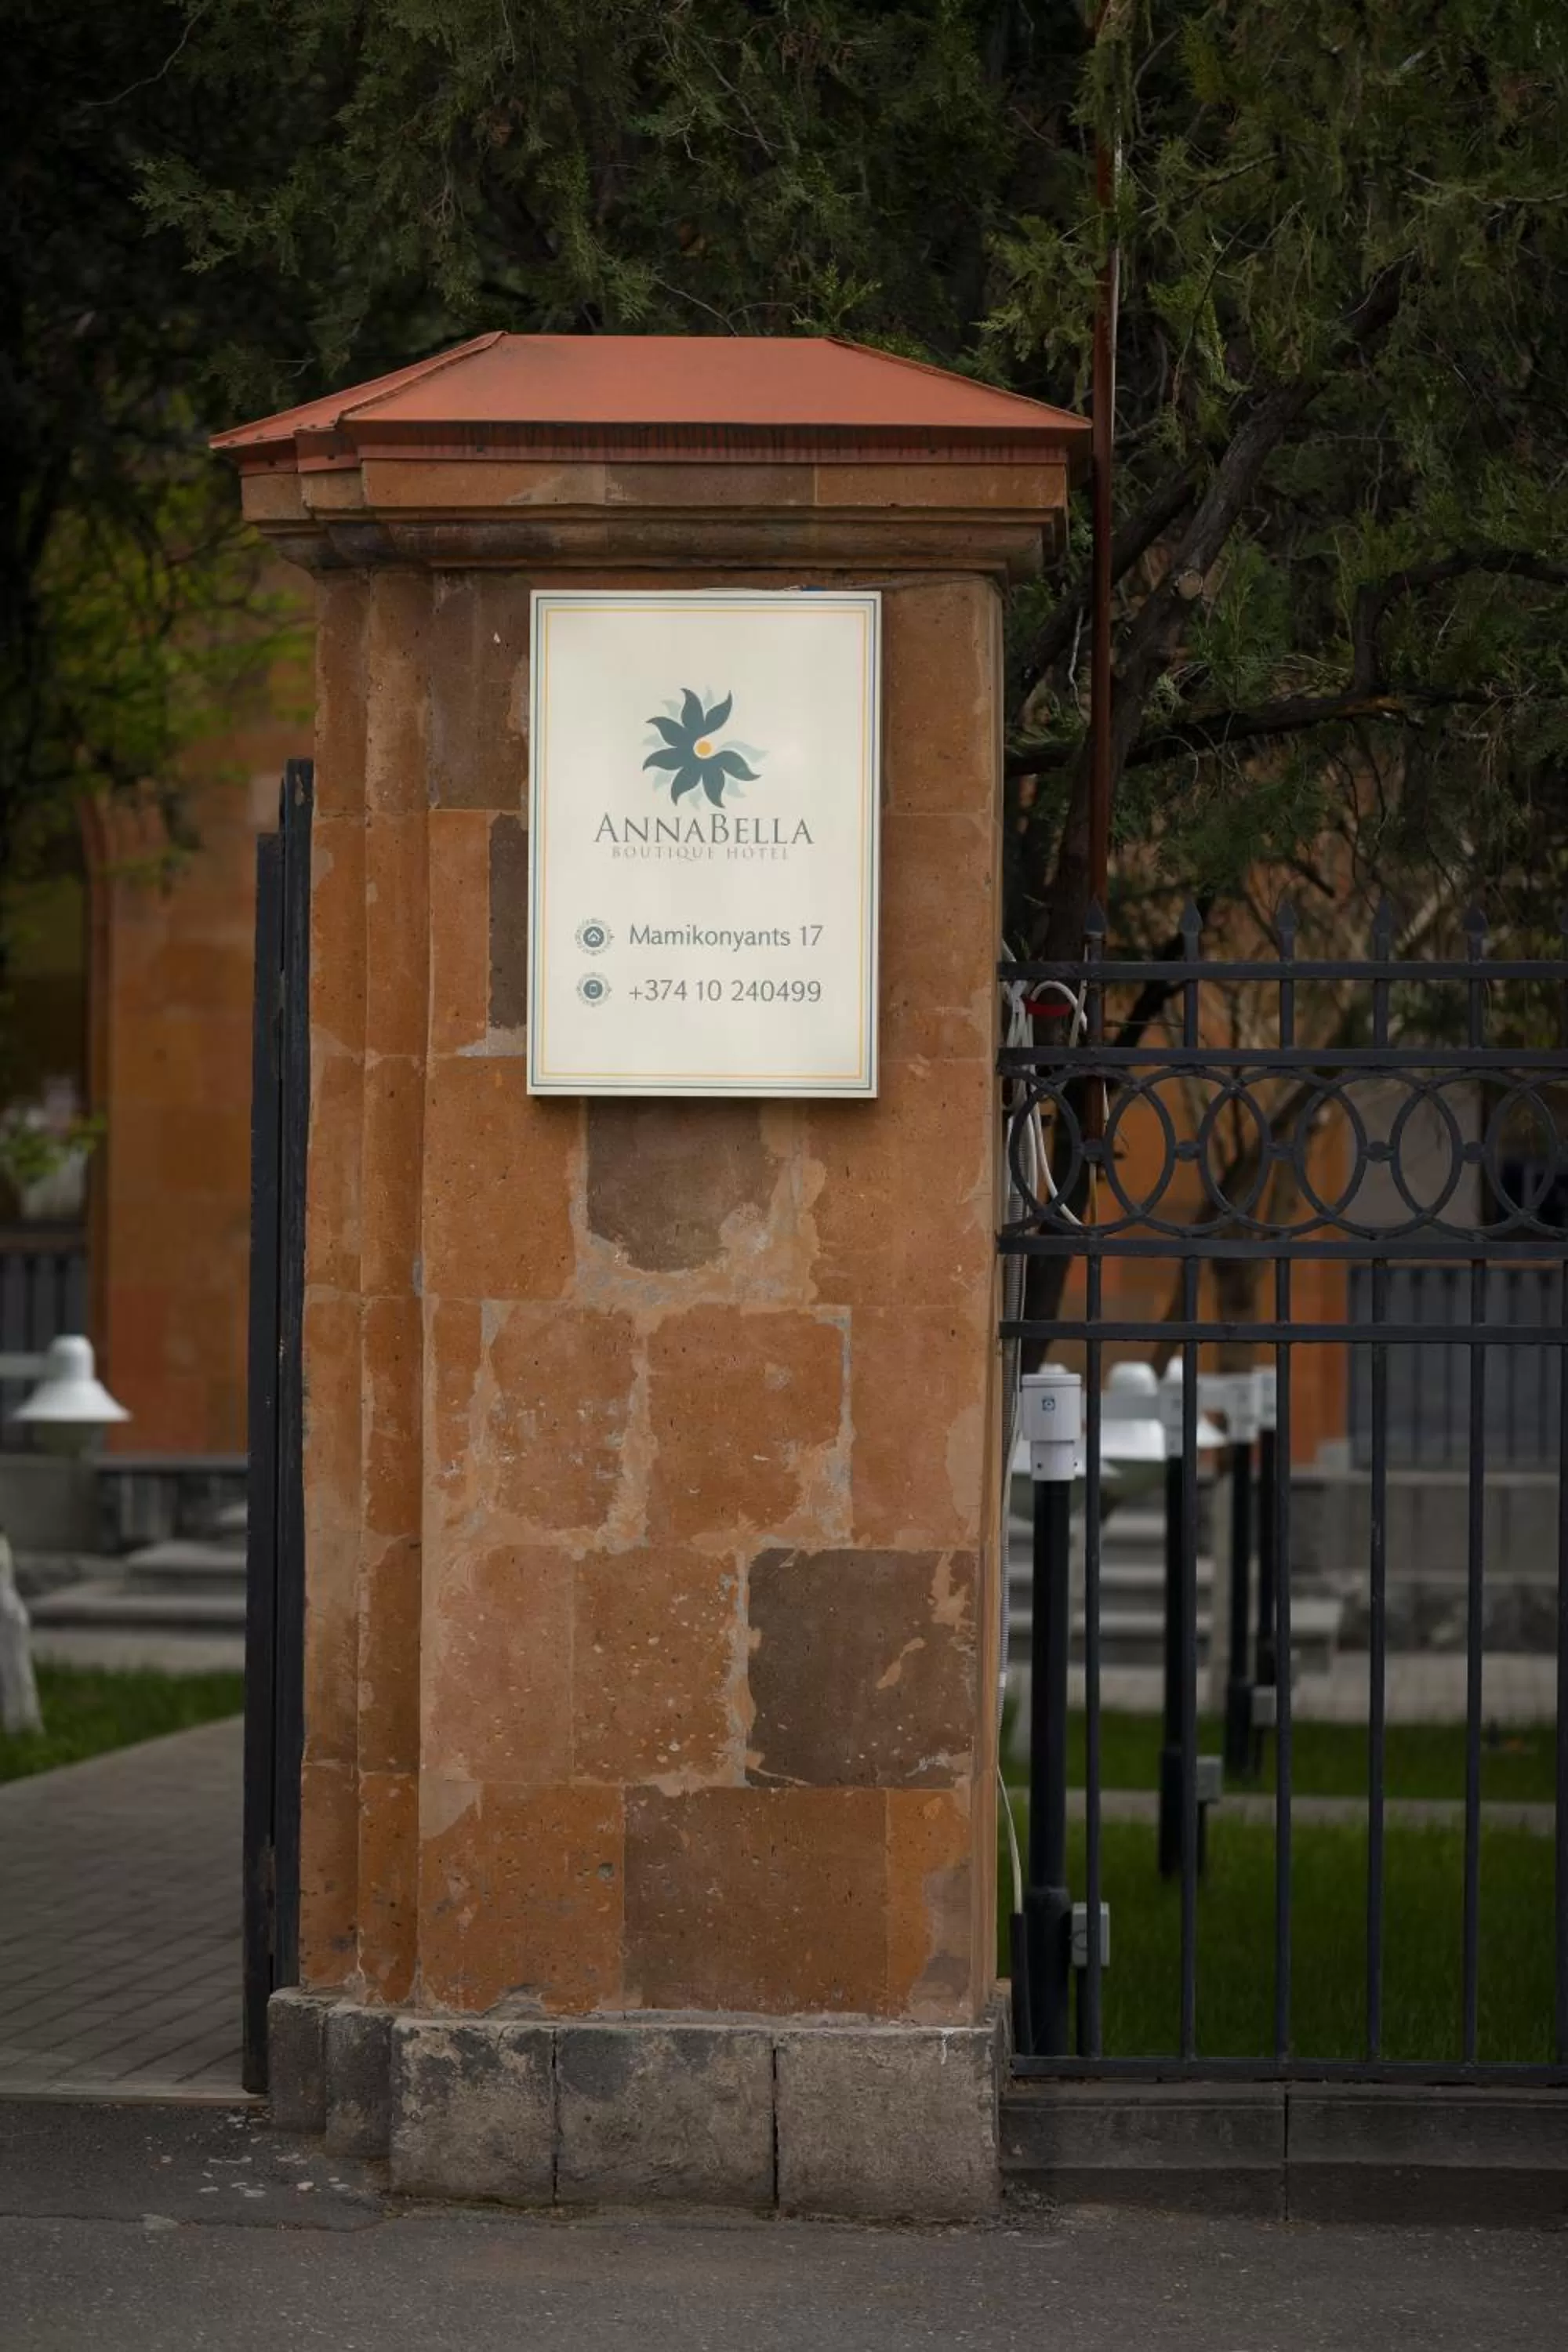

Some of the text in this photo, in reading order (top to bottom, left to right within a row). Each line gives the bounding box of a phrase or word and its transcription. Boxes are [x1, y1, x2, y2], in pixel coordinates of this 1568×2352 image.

[612, 846, 789, 862] BOUTIQUE HOTEL
[630, 924, 824, 952] Mamikonyants 17
[630, 980, 822, 1003] +374 10 240499
